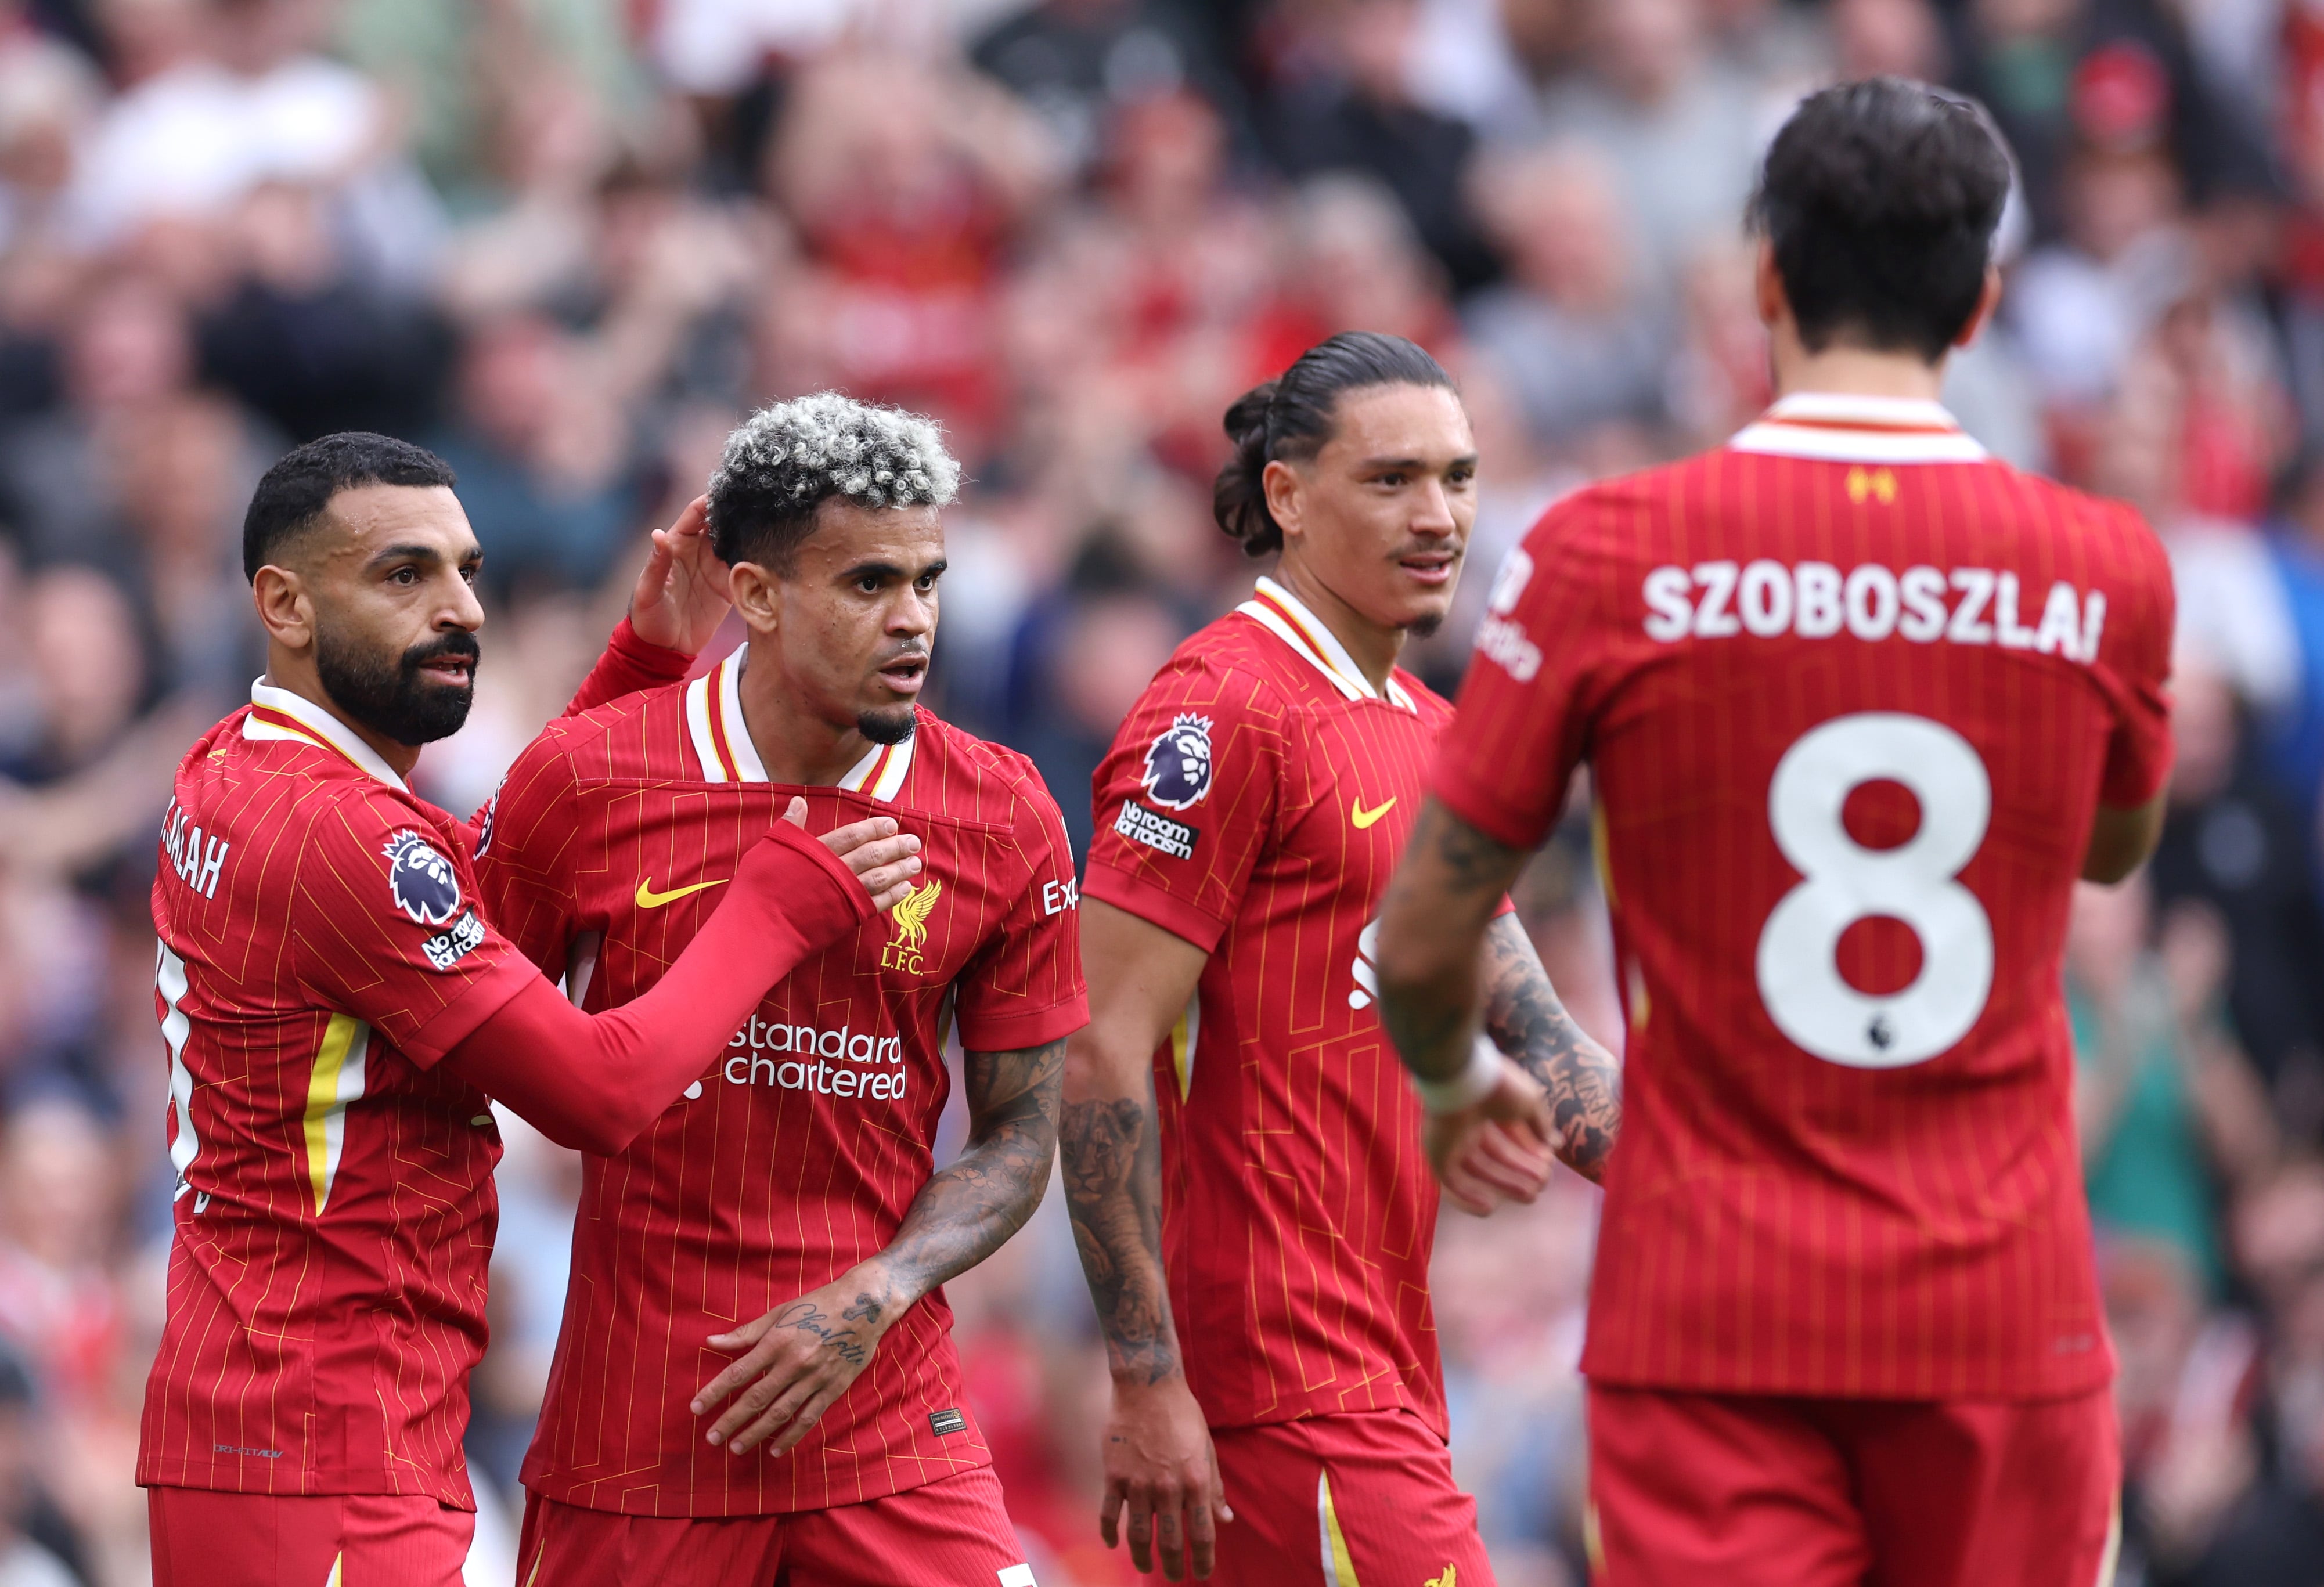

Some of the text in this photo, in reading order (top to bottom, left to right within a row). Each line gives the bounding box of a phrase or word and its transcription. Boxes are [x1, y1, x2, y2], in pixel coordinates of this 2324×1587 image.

[1642, 558, 2106, 666] SZOBOSZLAI
[1114, 814, 1192, 860] for racism
[1119, 799, 1190, 843] No room
[1754, 710, 1995, 1070] 8
[421, 935, 450, 960] No
[431, 947, 457, 972] for
[880, 946, 924, 977] L.F.C.
[728, 1013, 902, 1065] standard
[725, 1051, 907, 1101] chartered
